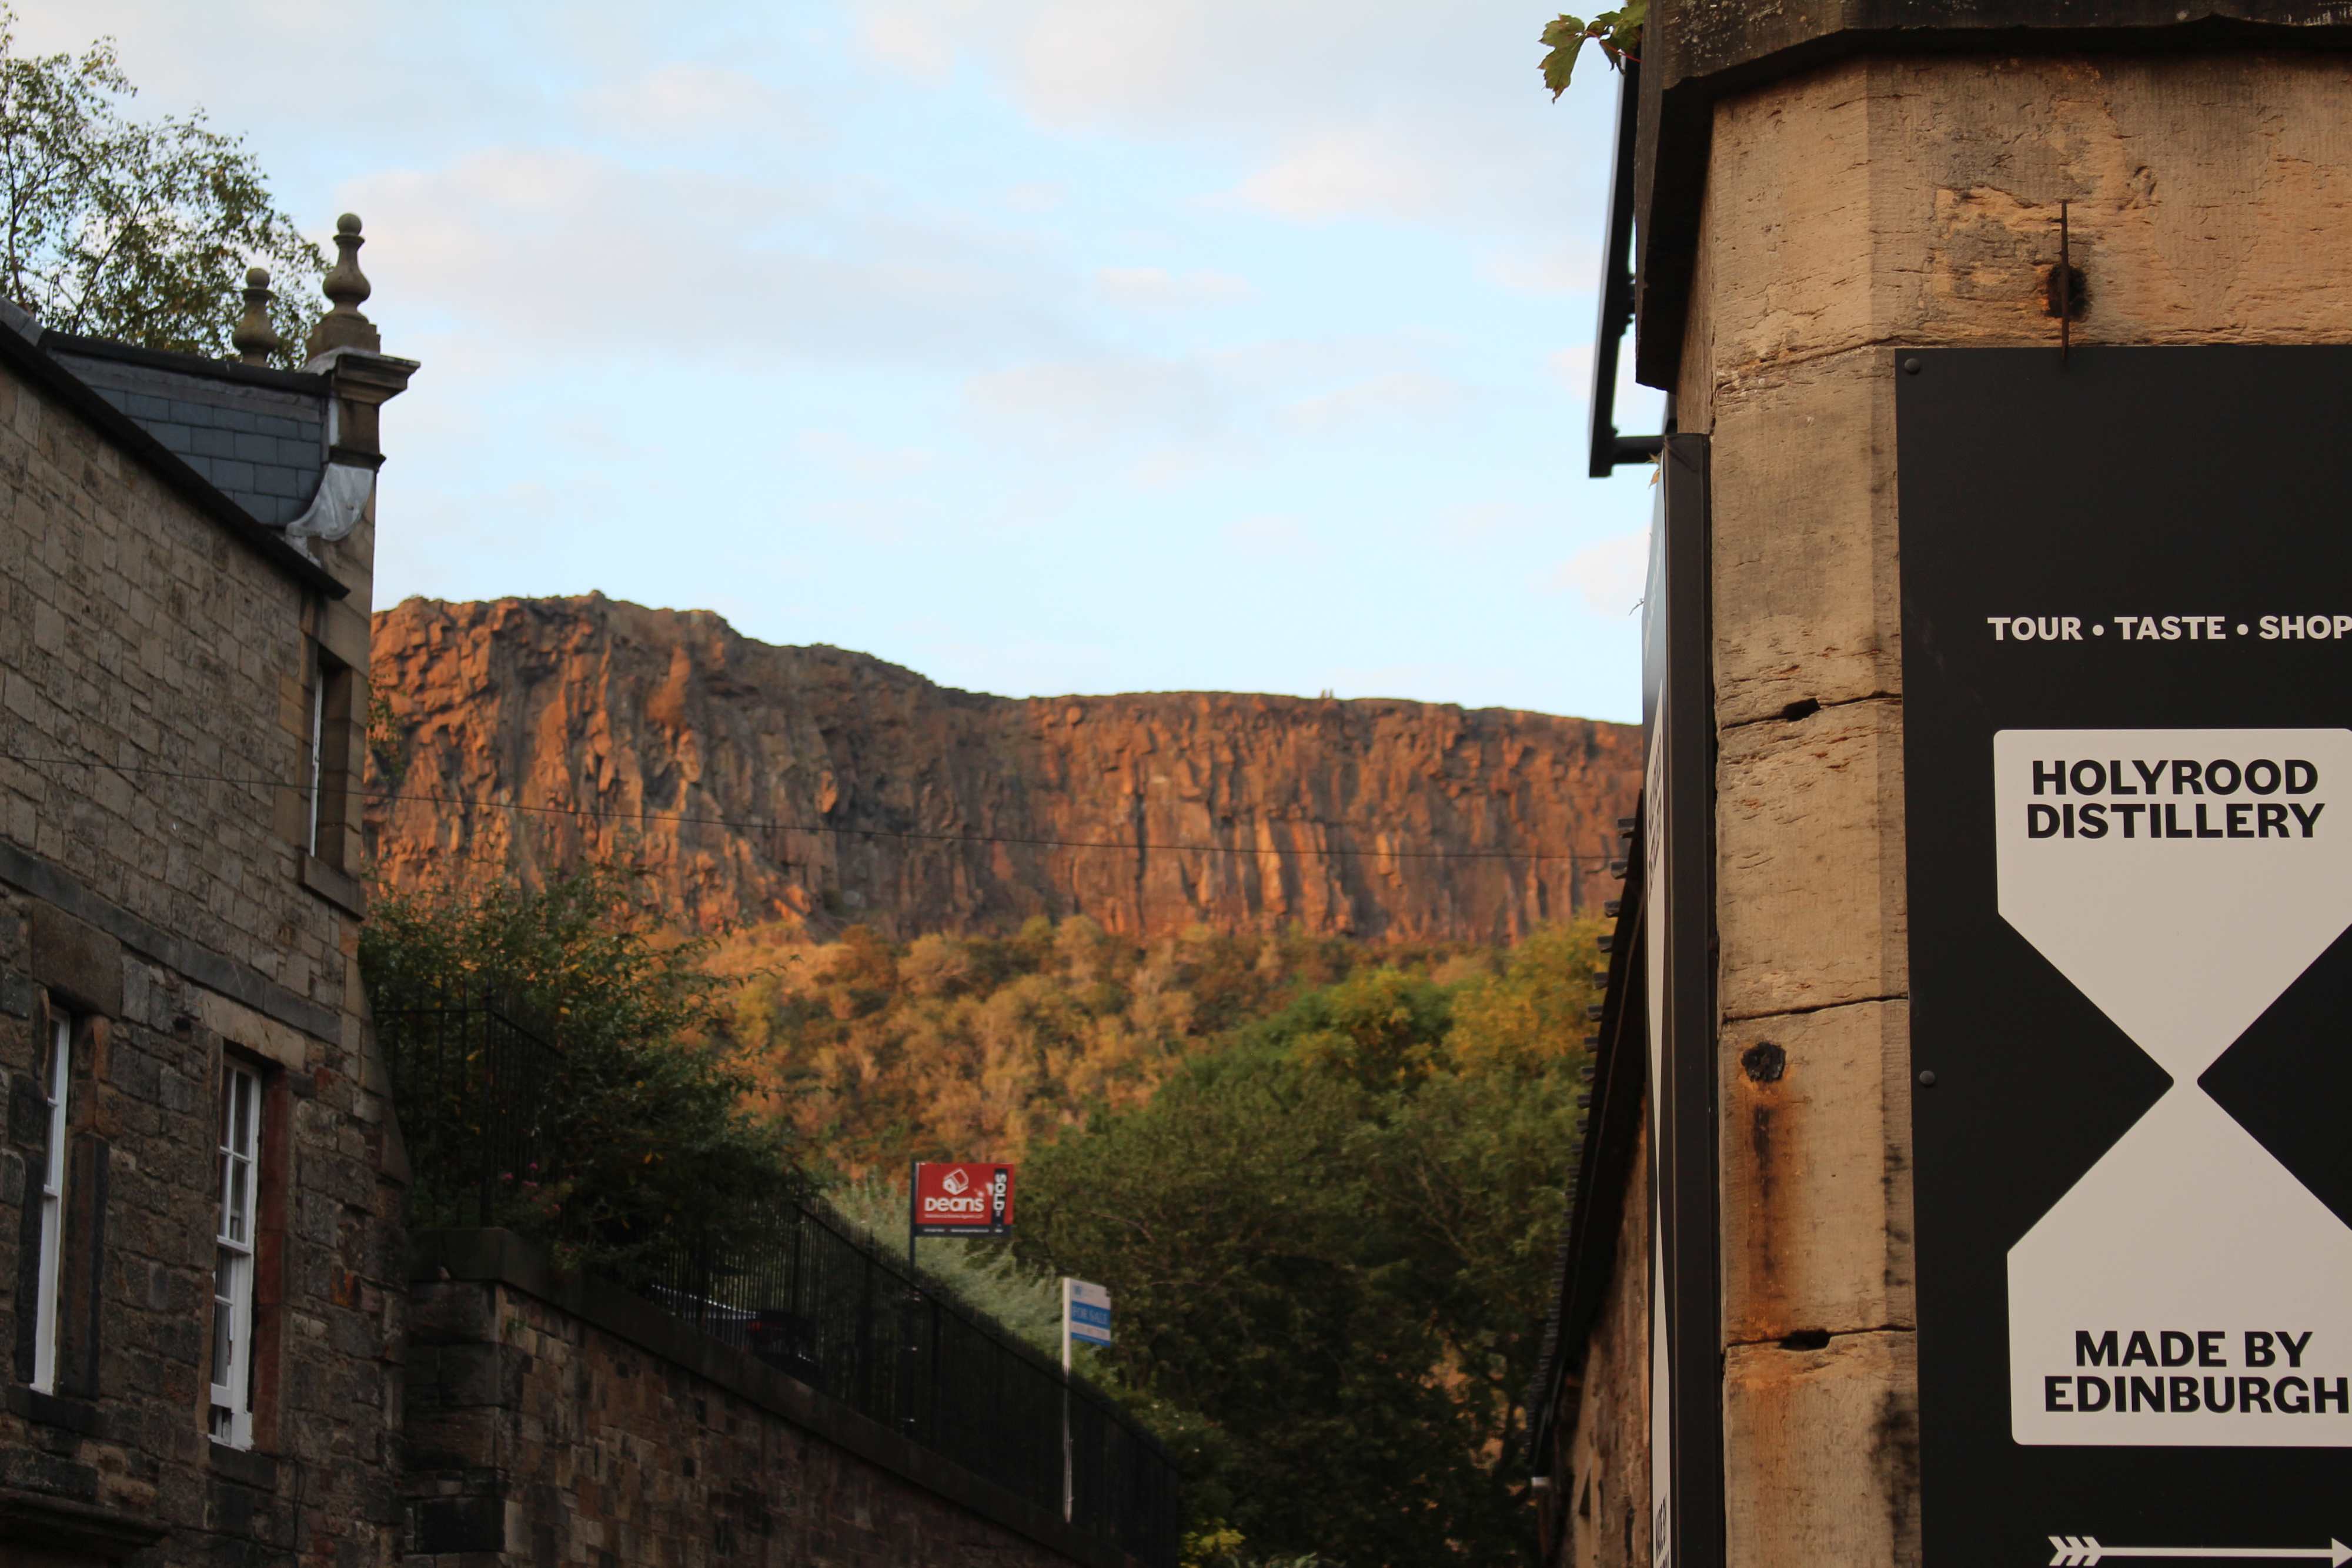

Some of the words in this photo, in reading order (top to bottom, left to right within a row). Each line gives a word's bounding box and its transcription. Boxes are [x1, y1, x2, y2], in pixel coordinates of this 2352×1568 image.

[1987, 617, 2083, 641] TOUR
[2114, 616, 2226, 640] TASTE
[2259, 615, 2352, 640] SHOP
[2032, 758, 2318, 796] HOLYROOD
[2027, 803, 2326, 839] DISTILLERY
[993, 1174, 1007, 1211] SOLD
[2075, 1330, 2227, 1368] MADE
[2244, 1331, 2313, 1368] BY
[2044, 1376, 2349, 1414] EDINBURGH
